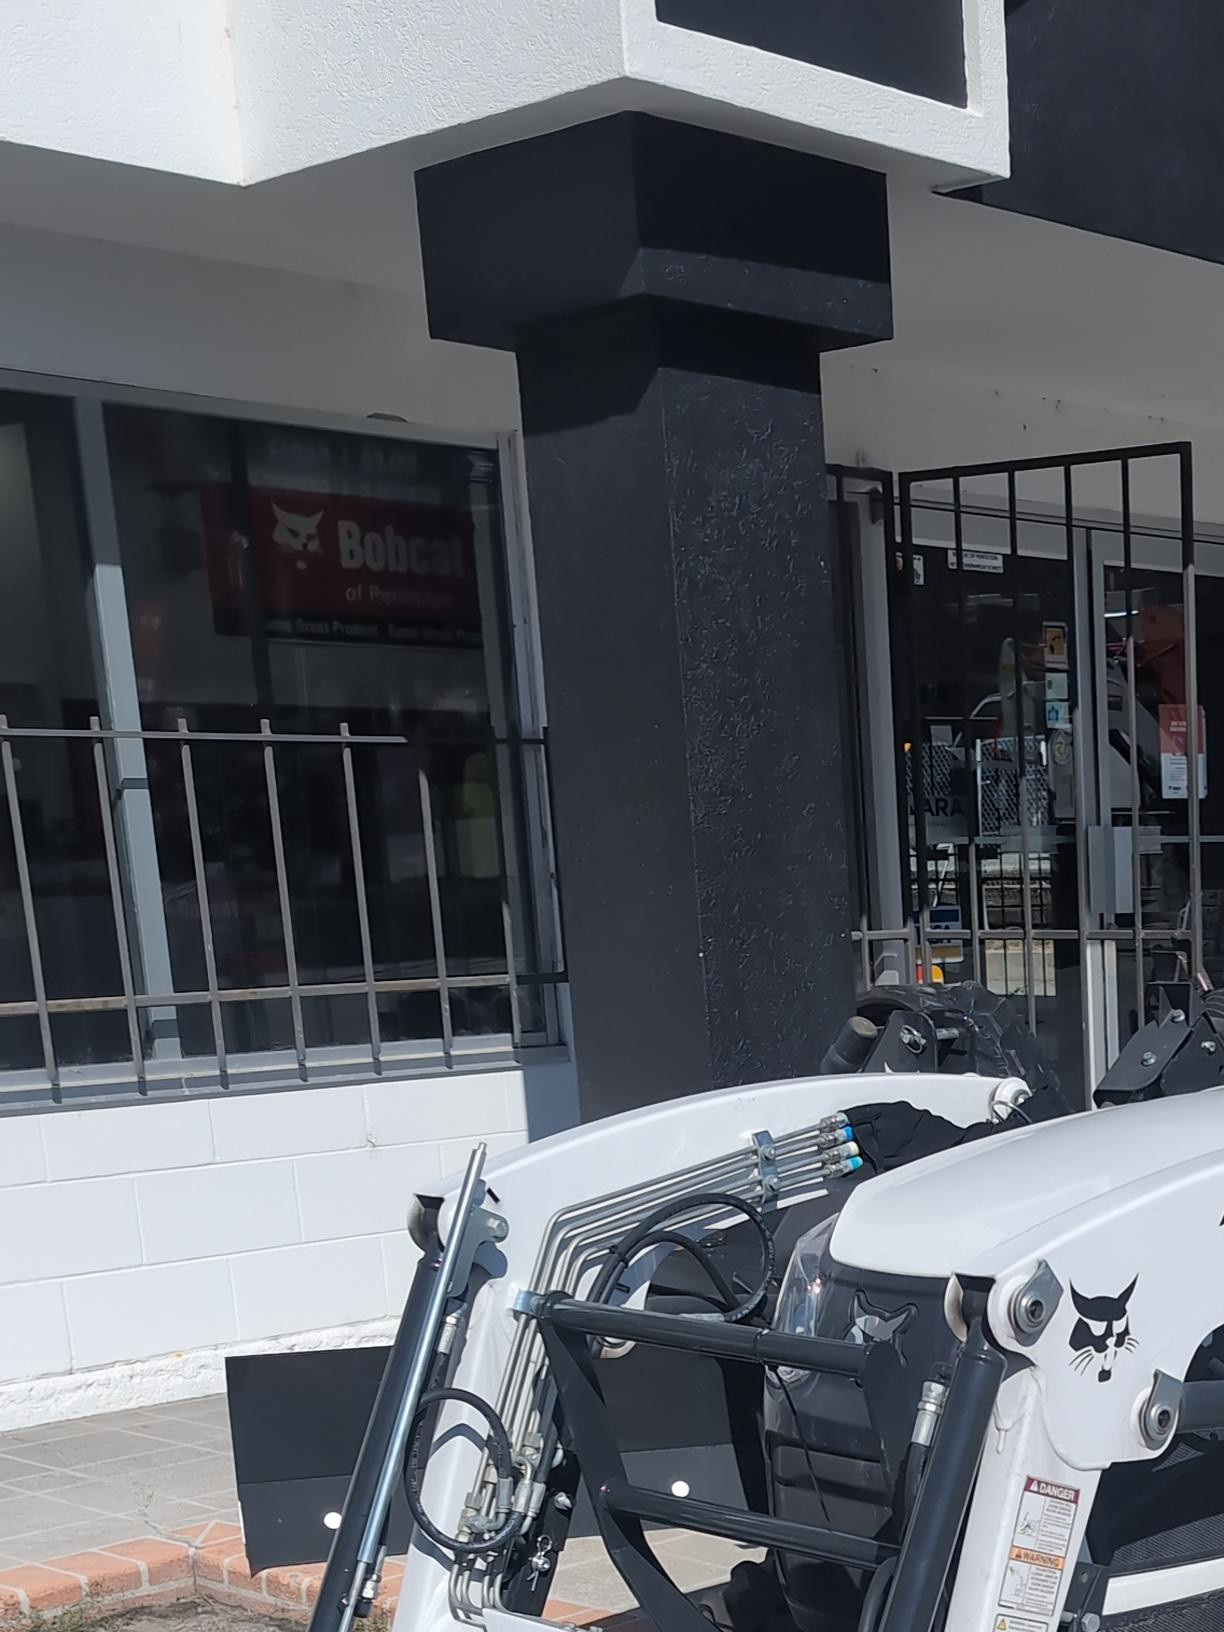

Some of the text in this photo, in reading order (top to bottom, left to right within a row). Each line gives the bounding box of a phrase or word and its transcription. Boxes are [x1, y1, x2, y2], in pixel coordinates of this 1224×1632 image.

[337, 519, 465, 577] Bobcat
[1039, 1482, 1075, 1501] DANGER
[1023, 1550, 1060, 1567] WARNING
